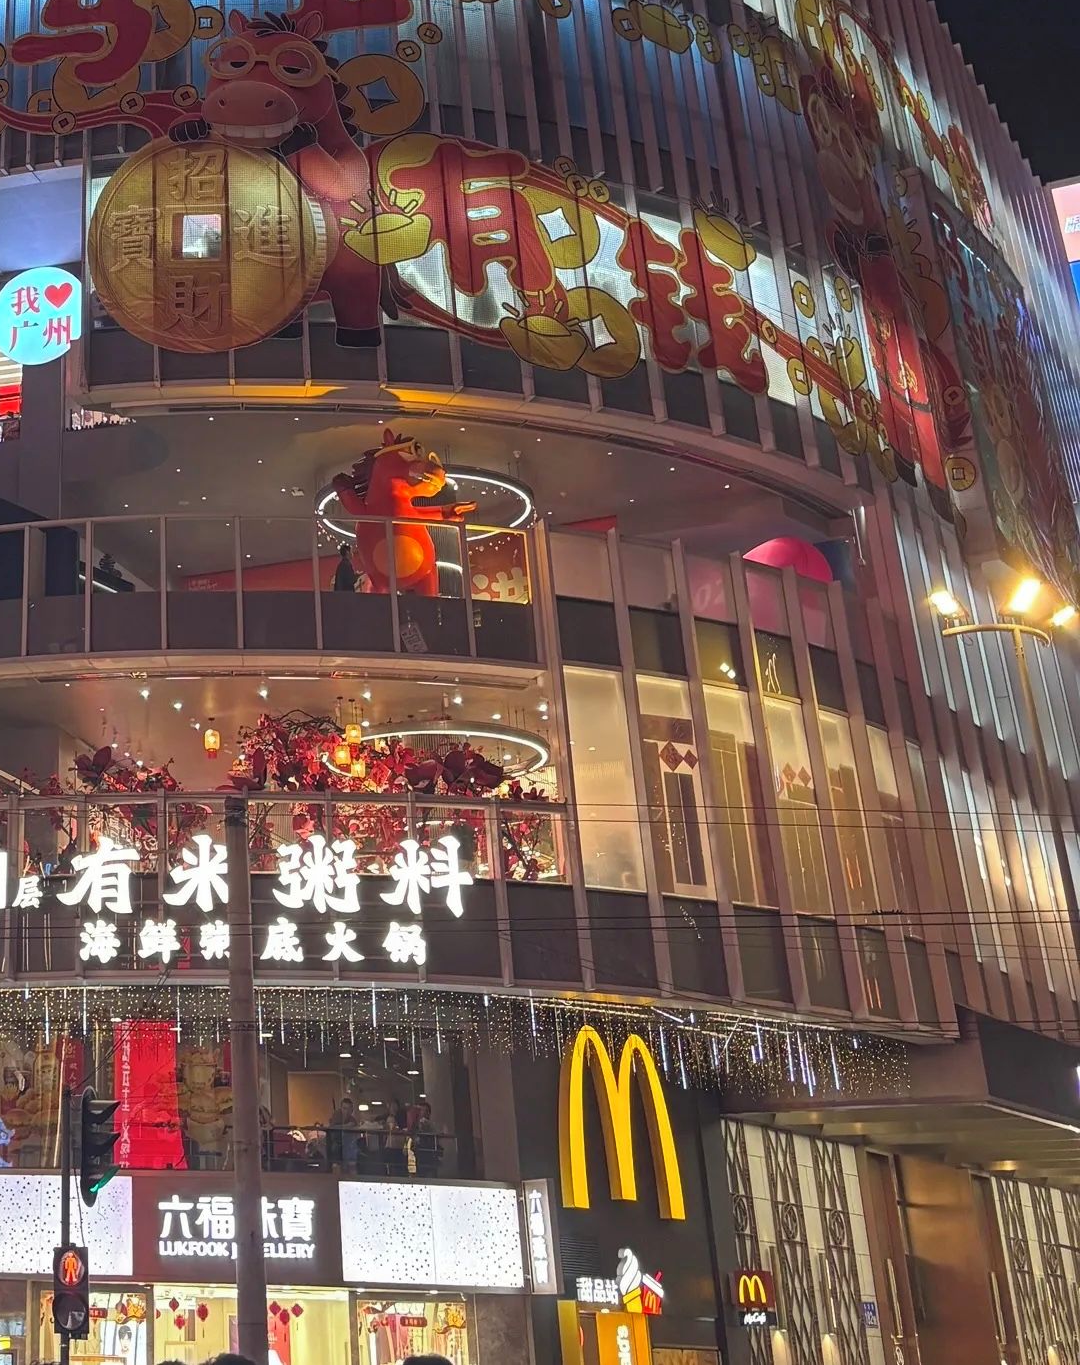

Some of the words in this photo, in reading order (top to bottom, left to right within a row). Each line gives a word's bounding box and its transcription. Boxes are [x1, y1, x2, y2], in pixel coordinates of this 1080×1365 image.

[10, 286, 40, 316] 我
[9, 315, 71, 353] 广州
[159, 1240, 229, 1257] LUKFOOK
[231, 1242, 316, 1259] JELLERY
[576, 1277, 619, 1305] 甜品站
